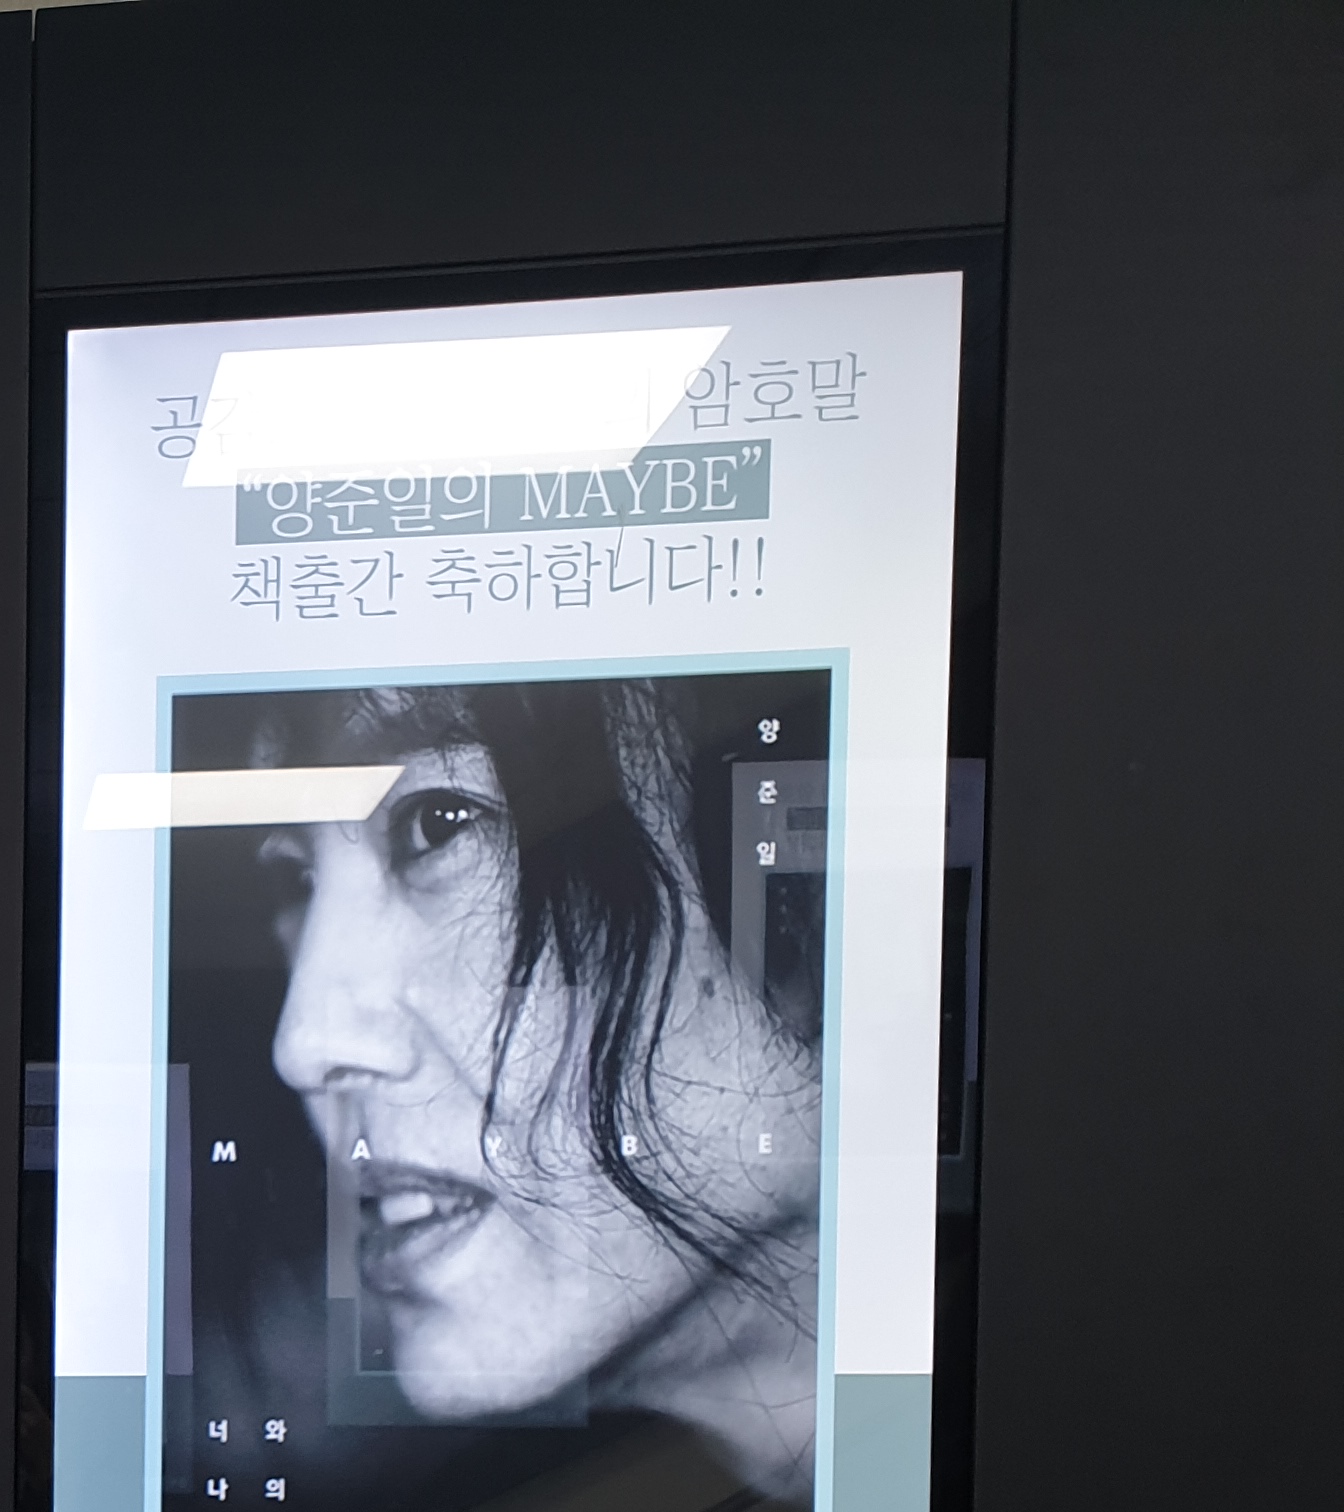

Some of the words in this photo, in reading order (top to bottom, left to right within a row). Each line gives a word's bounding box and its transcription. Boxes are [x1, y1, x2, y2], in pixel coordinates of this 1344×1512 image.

[683, 350, 868, 432] 암호말
[518, 444, 764, 521] MAYBE”
[230, 547, 405, 623] 책출간
[424, 533, 765, 615] 축하합니다!!
